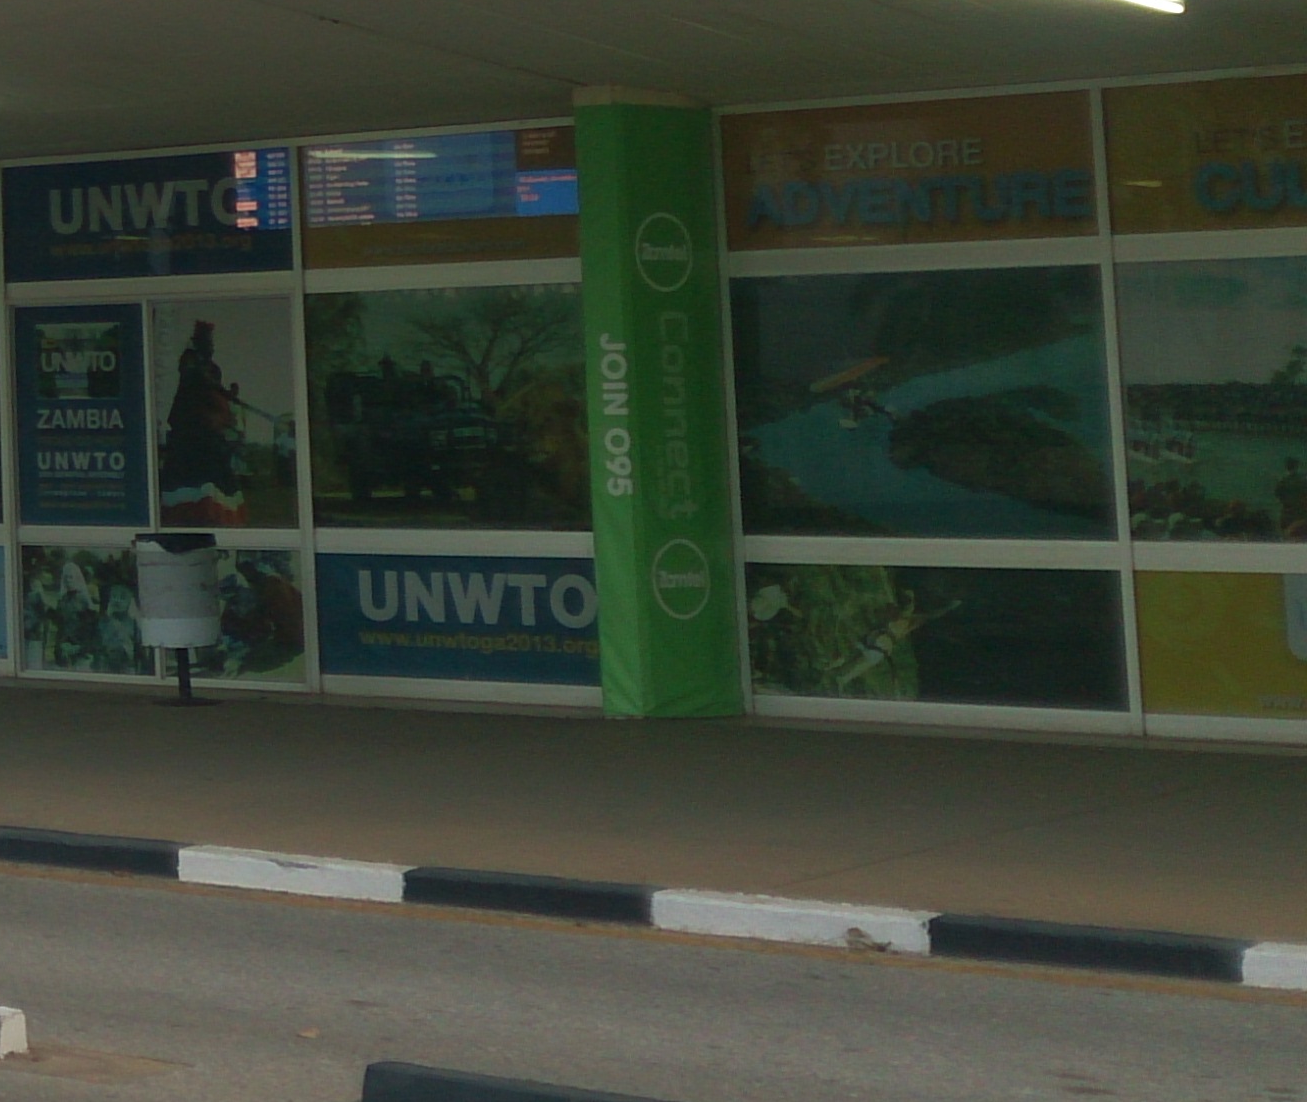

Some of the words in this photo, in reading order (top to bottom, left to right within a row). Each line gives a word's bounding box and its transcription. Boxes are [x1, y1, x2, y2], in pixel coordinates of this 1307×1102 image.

[822, 137, 985, 171] EXPLORE
[746, 167, 1094, 226] ADVENTURE
[40, 350, 117, 373] UNWTO
[600, 333, 628, 416] JOIN
[35, 408, 125, 430] ZAMBIA
[657, 310, 699, 522] Connect
[36, 451, 126, 472] UNWTO
[357, 569, 598, 630] UNWTO
